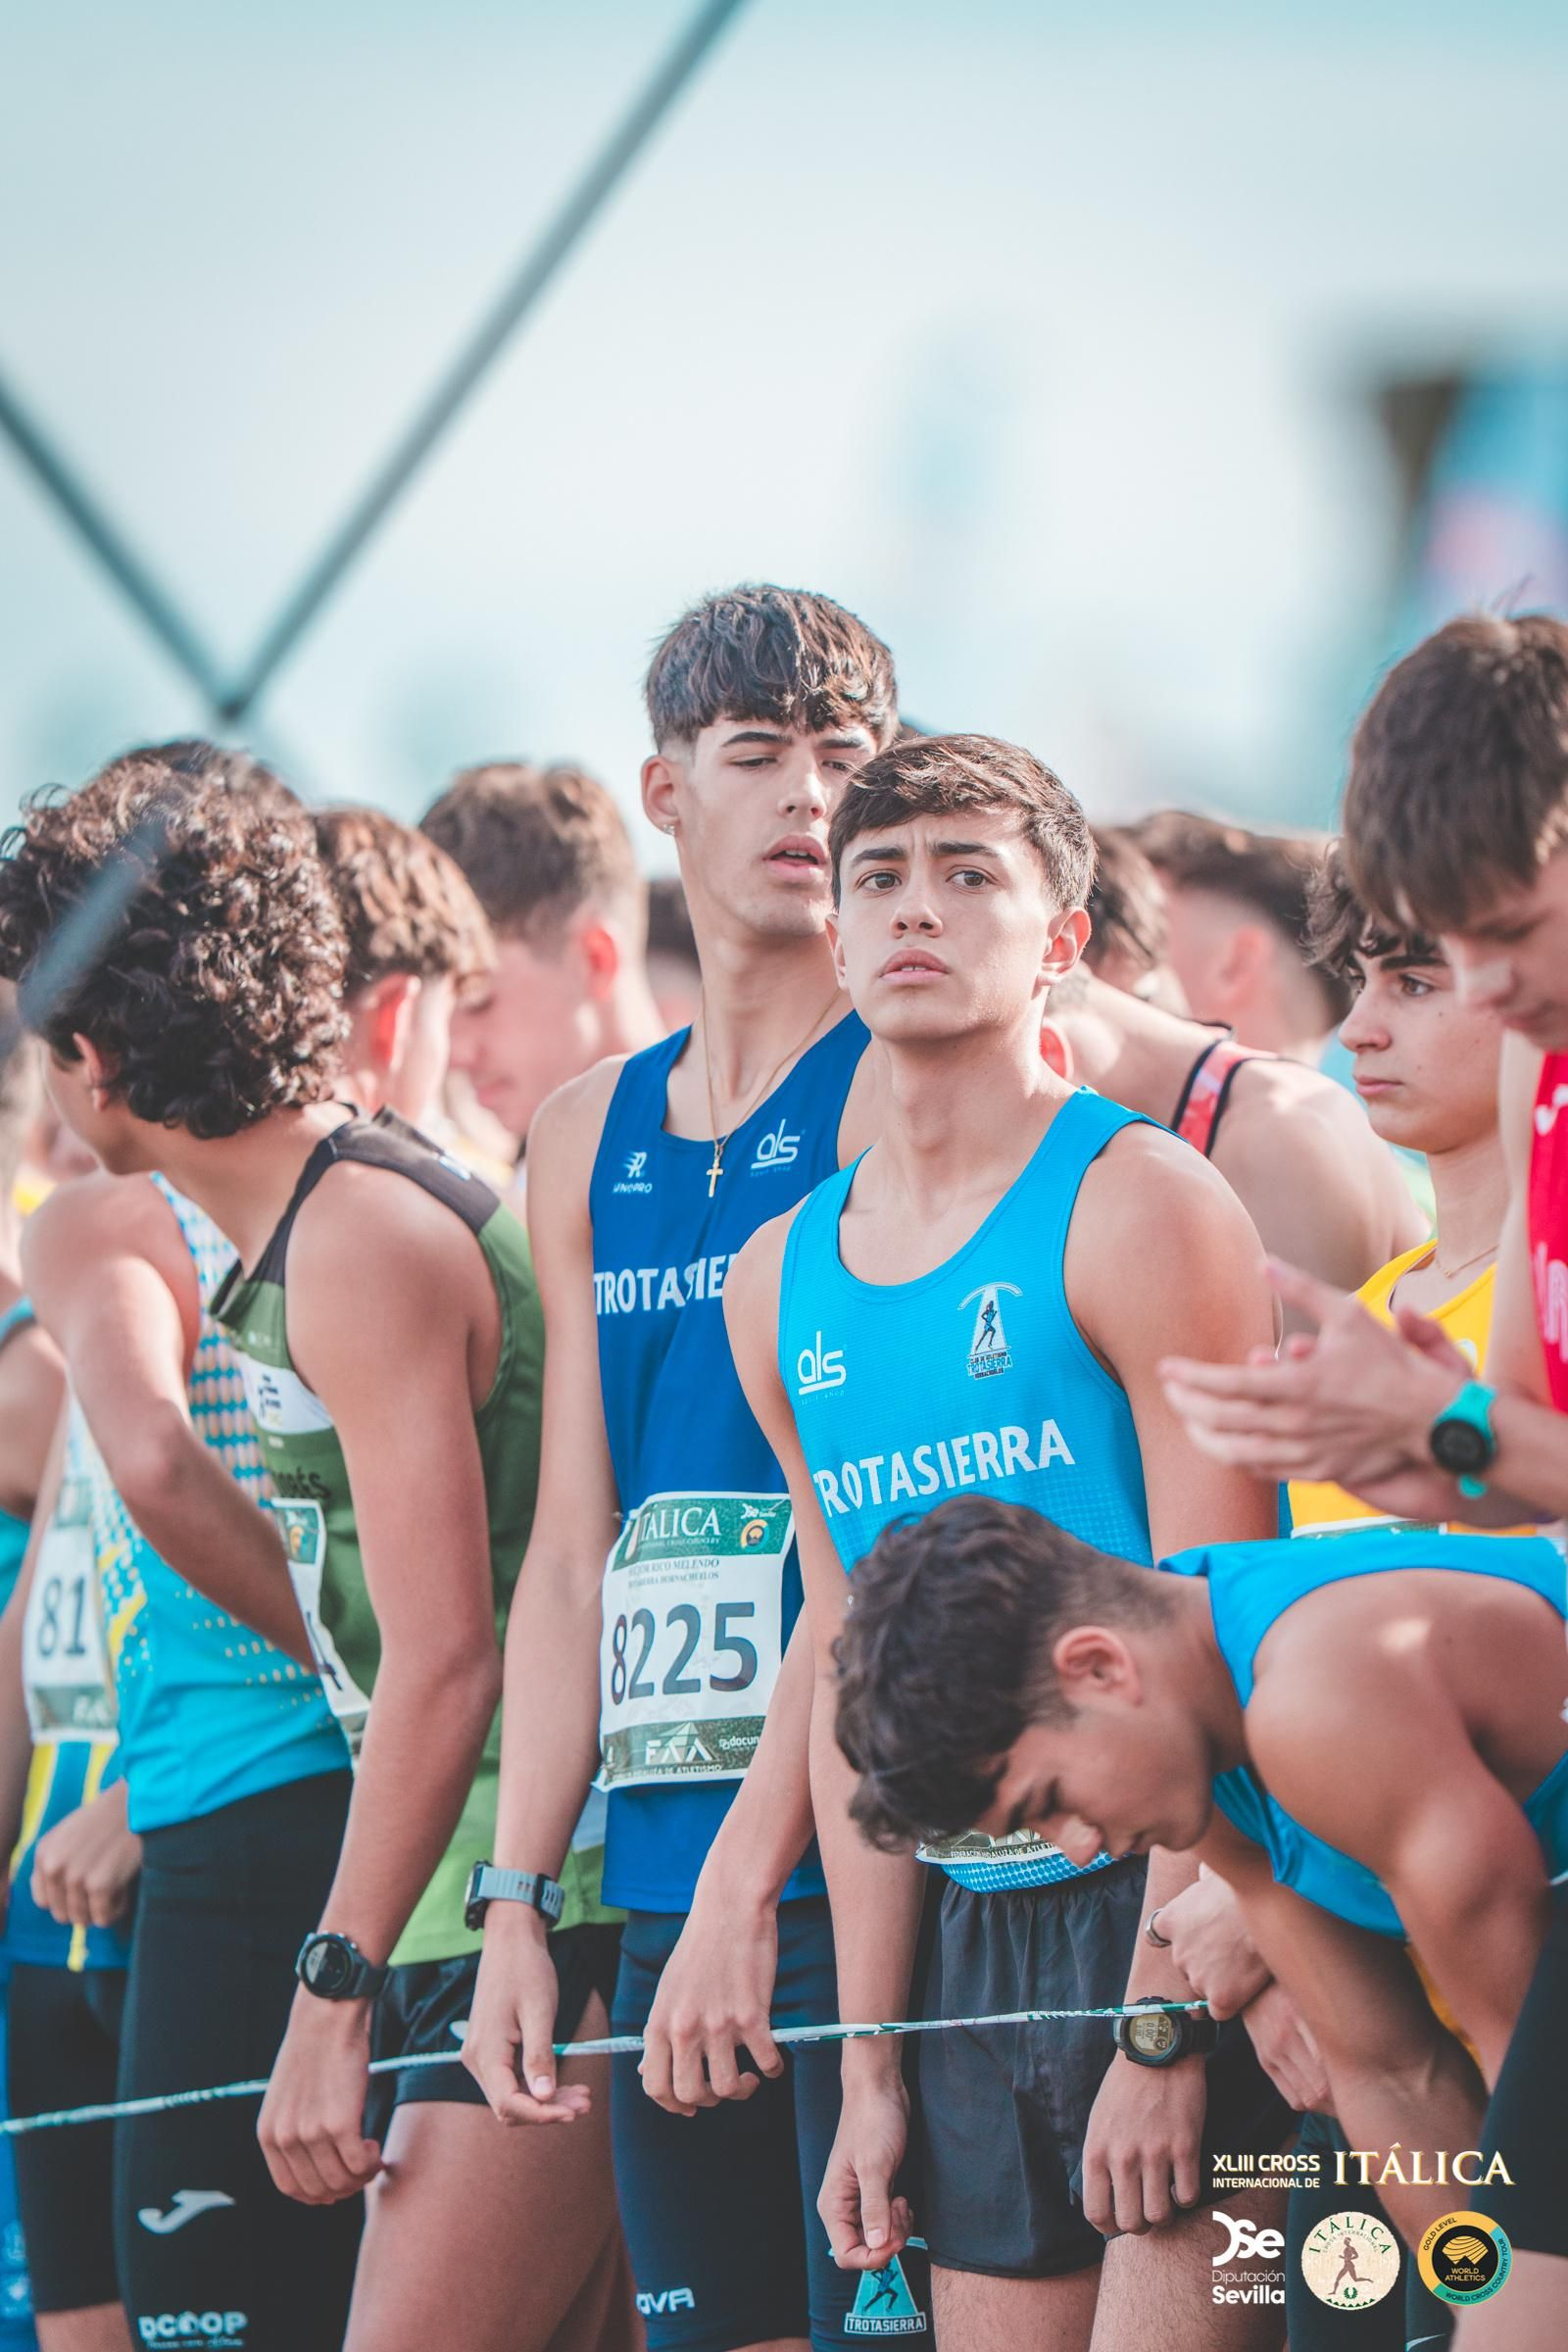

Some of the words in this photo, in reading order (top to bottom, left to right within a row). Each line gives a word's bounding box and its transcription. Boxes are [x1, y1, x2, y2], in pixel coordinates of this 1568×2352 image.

[673, 1559, 720, 1570] MELENDO
[612, 1601, 759, 1705] 8225
[676, 1764, 722, 1775] ATLETISMO
[849, 2317, 924, 2332] TROTASIERRA
